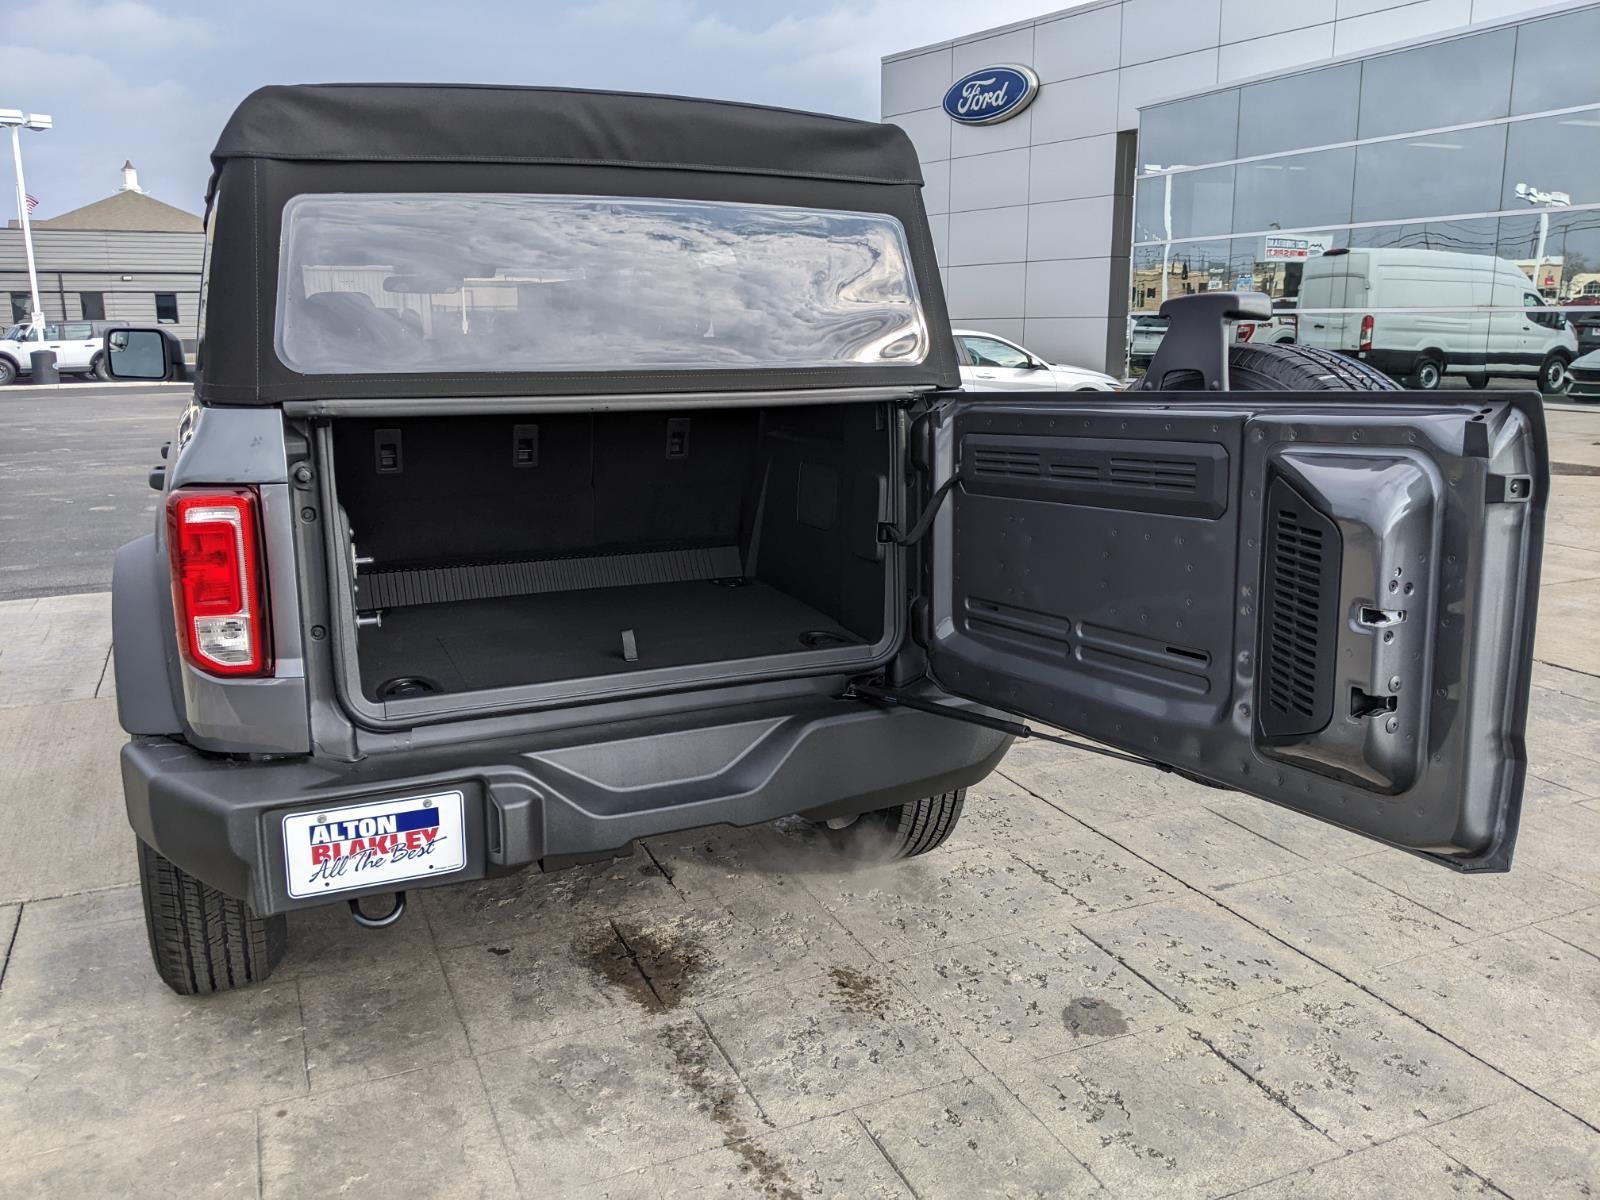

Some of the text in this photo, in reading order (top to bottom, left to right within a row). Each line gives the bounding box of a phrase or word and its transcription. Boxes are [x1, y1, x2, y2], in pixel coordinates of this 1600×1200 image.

[957, 77, 1009, 114] Ford
[311, 814, 398, 845] ALTON
[311, 827, 439, 866] BLAKLEY
[308, 836, 447, 883] All The Best
